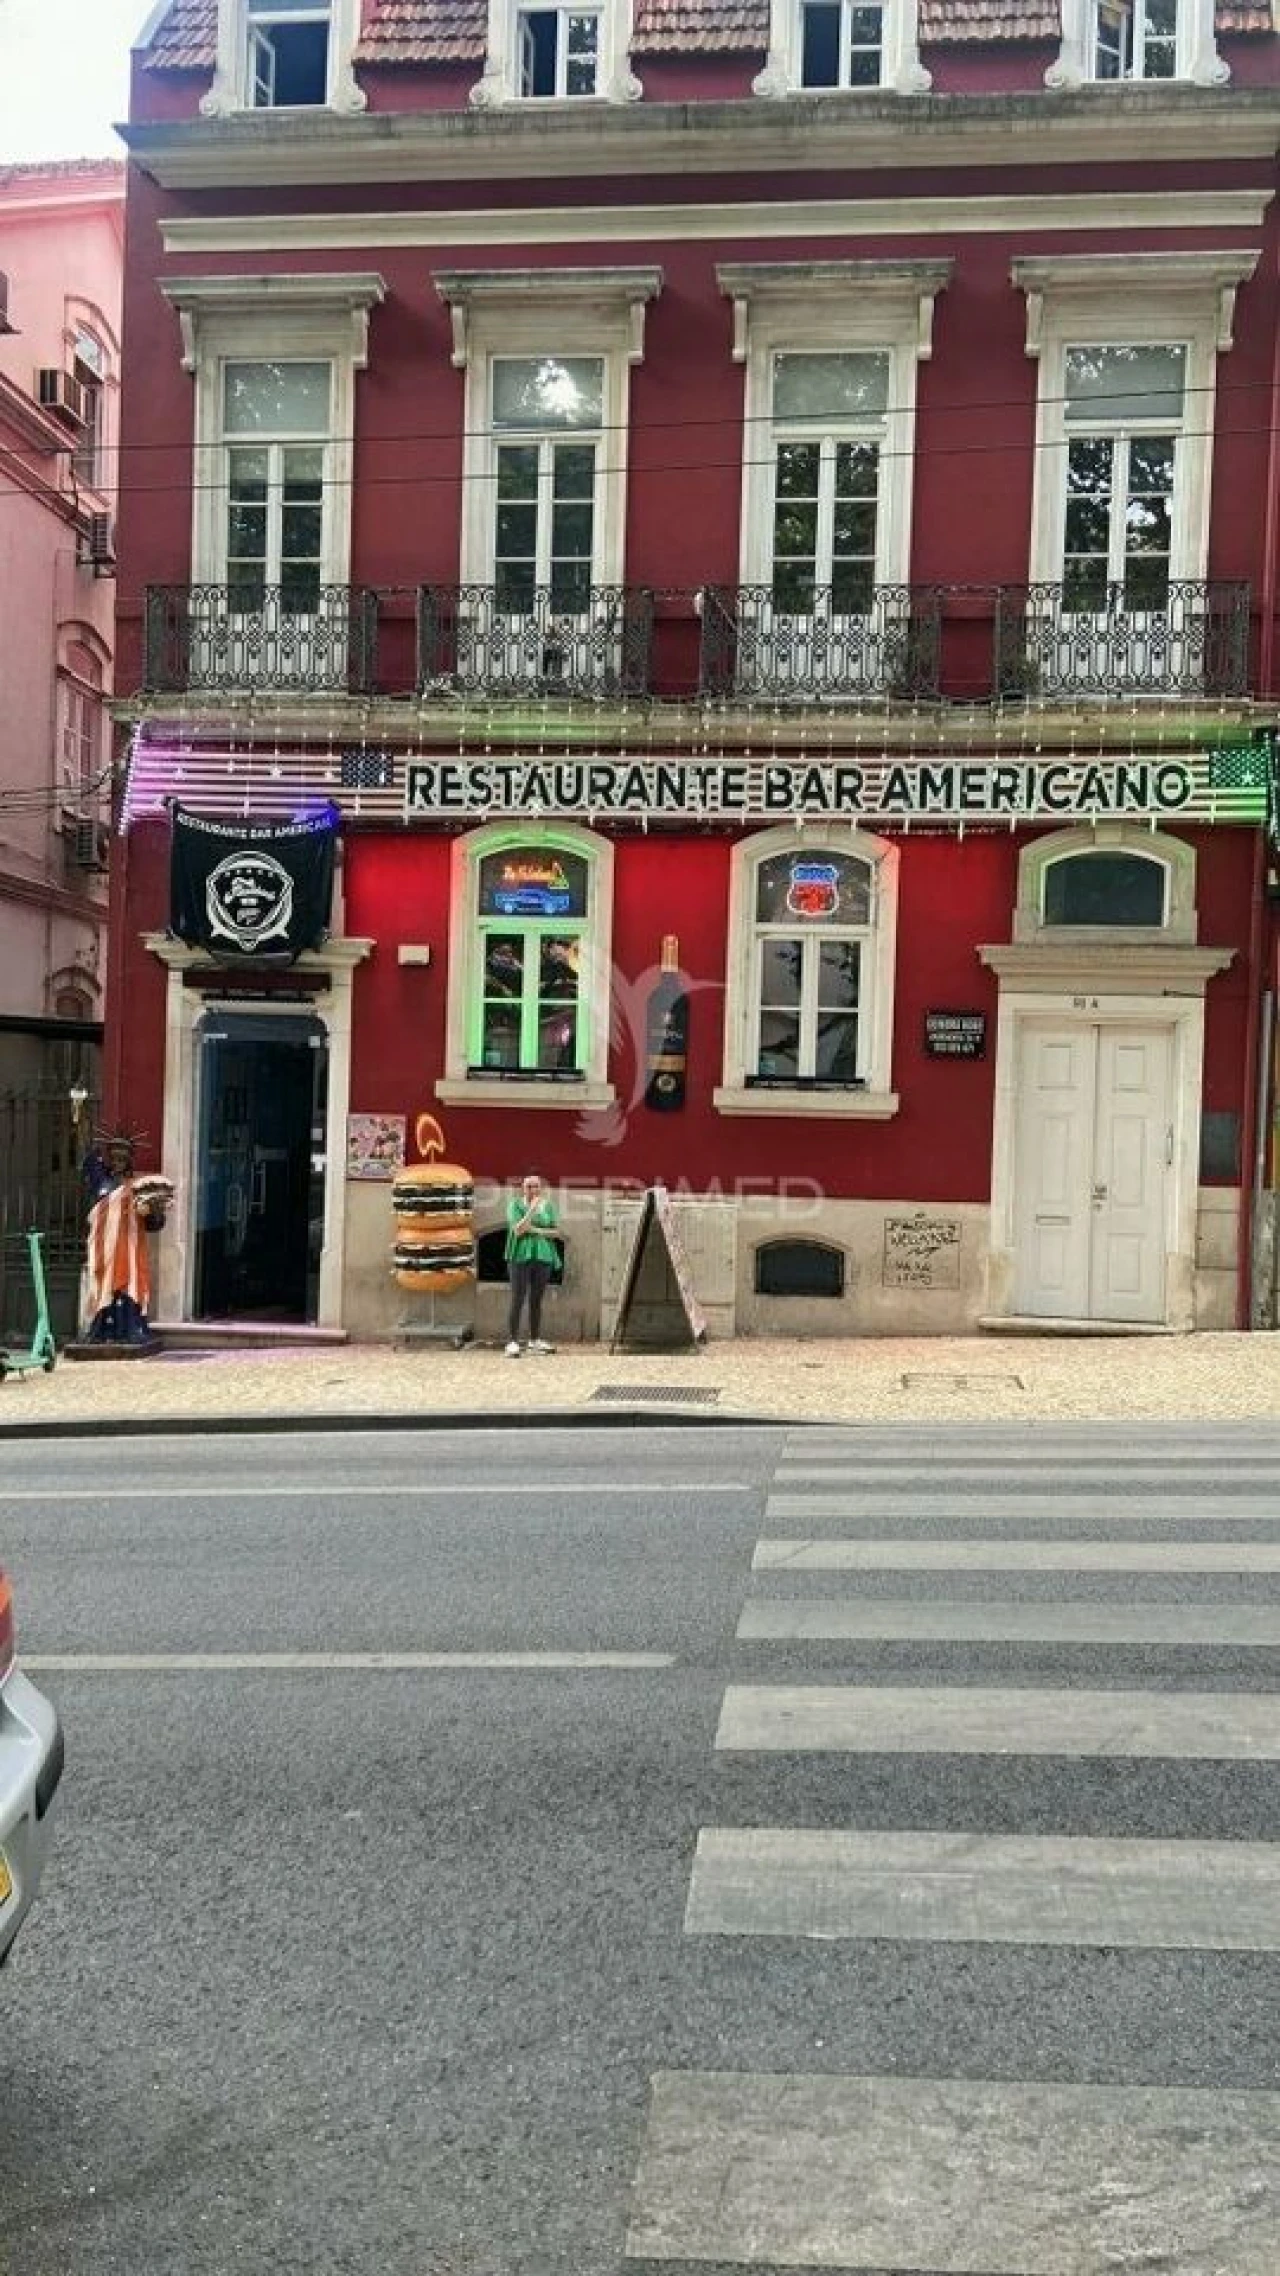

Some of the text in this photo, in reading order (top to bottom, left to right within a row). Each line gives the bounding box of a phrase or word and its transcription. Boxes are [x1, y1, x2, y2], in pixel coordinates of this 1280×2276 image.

[409, 764, 1191, 809] RESTAURANTE BAR AMERICANO
